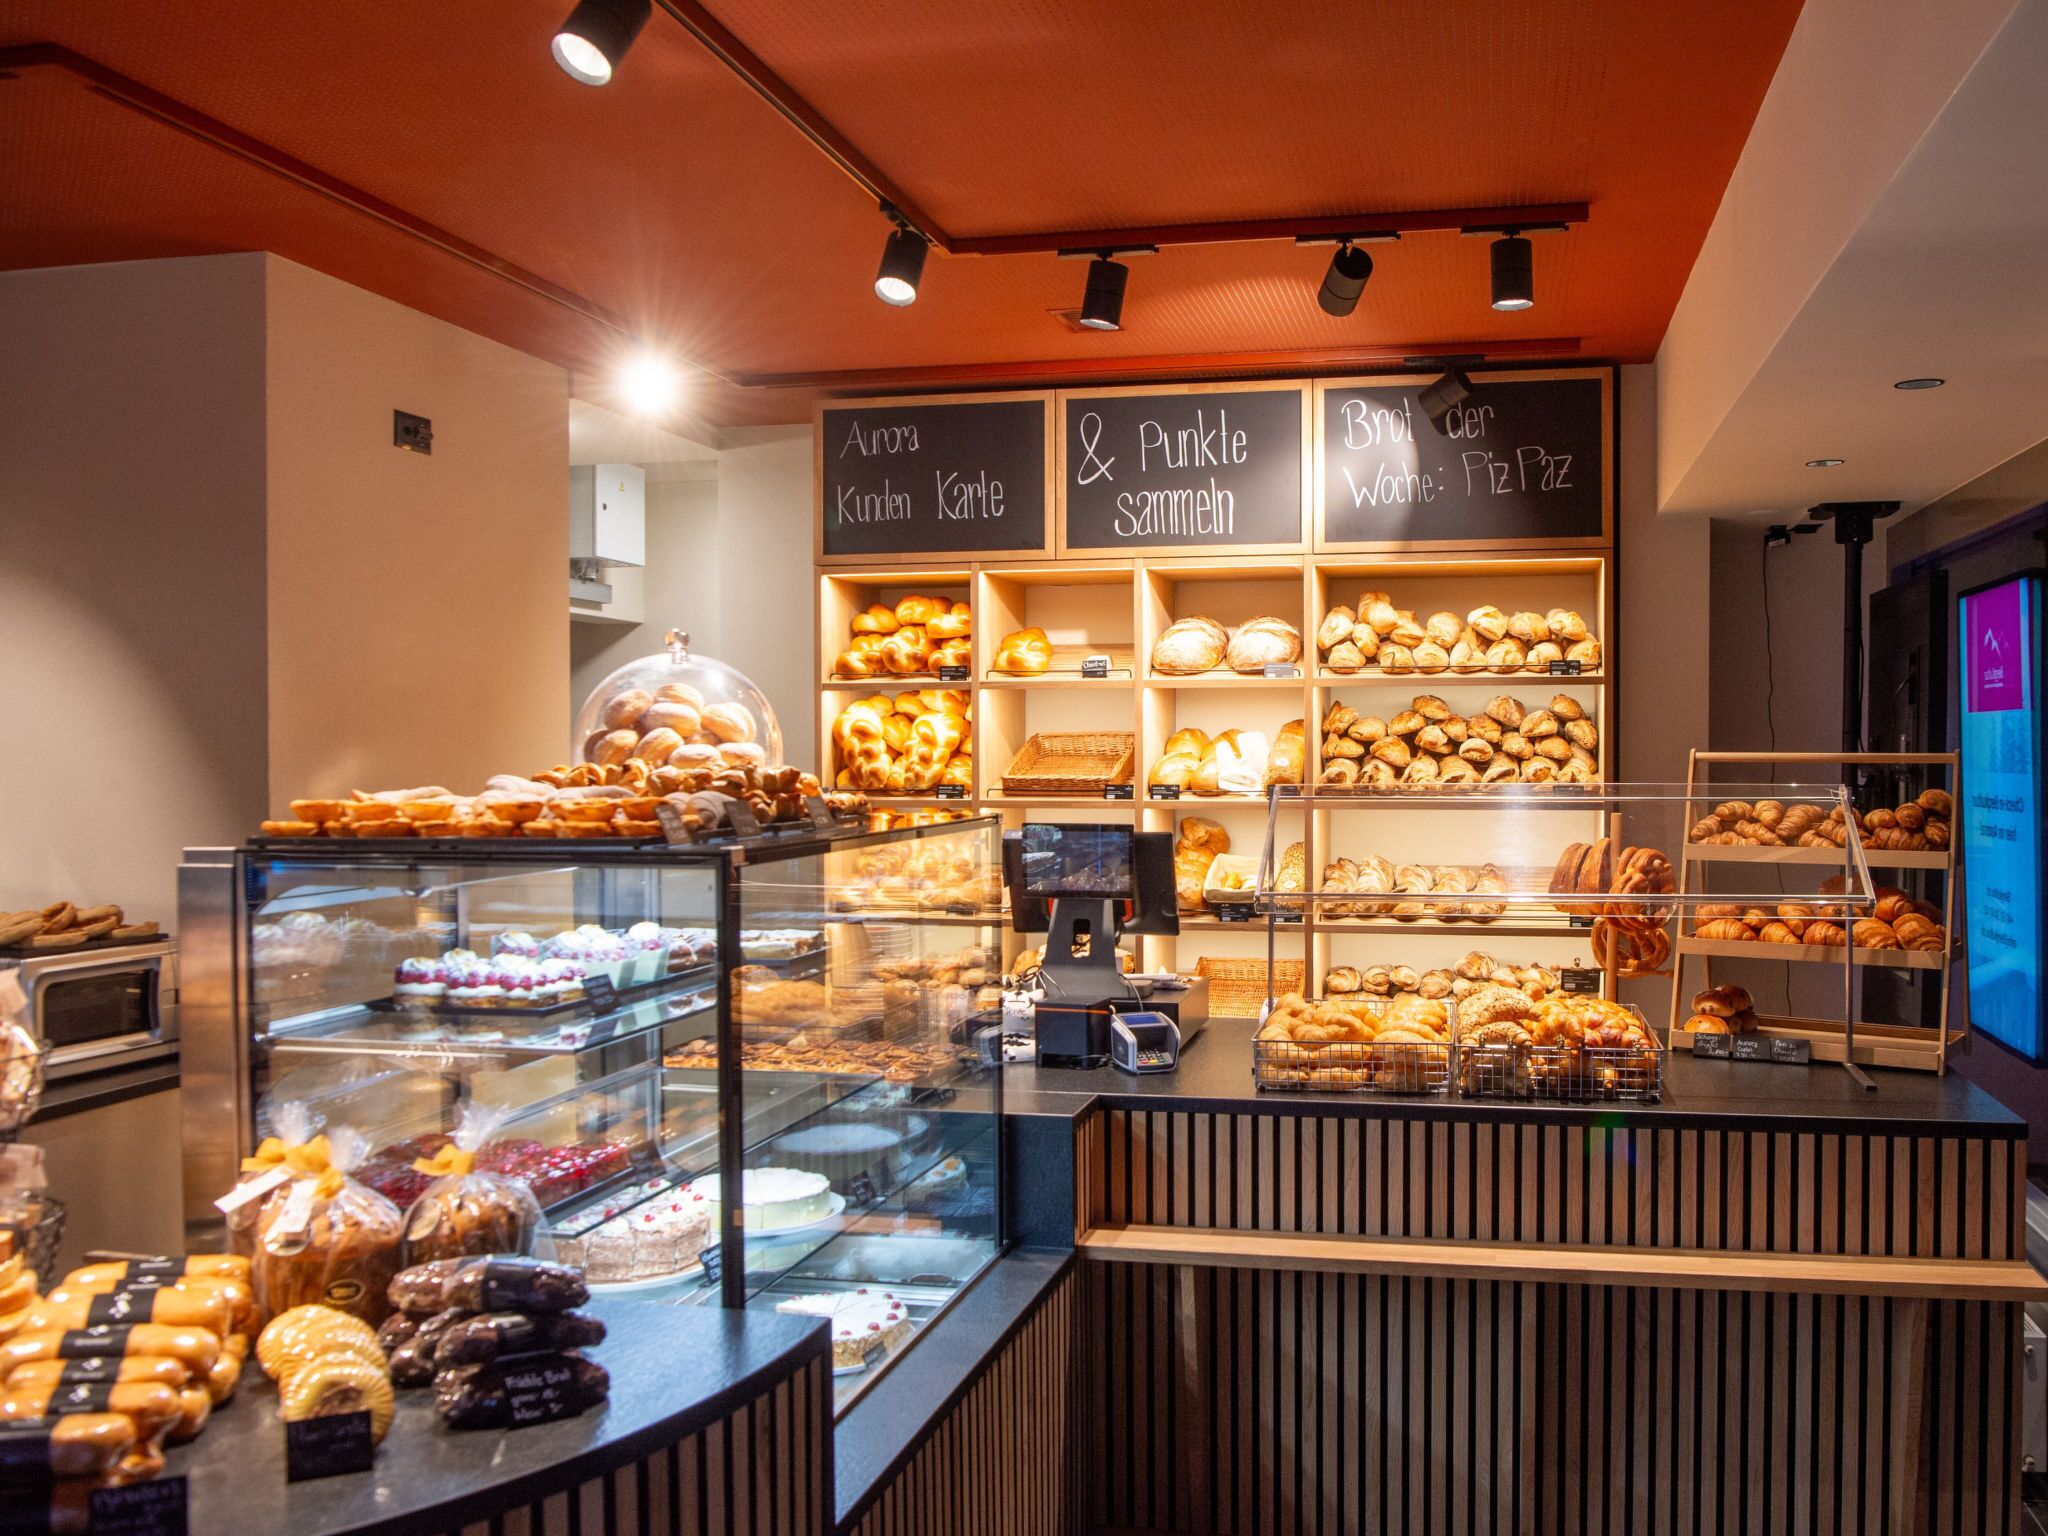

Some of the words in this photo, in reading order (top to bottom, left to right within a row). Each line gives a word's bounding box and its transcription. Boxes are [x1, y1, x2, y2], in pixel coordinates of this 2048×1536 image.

[839, 420, 919, 459] Aurora
[1077, 412, 1115, 485] &
[1139, 409, 1247, 472] Punkte
[1340, 397, 1415, 450] Brot
[1445, 402, 1494, 439] der
[837, 479, 911, 524] Kunden
[936, 470, 1004, 520] Karte
[1114, 477, 1234, 536] sammeln
[1342, 462, 1444, 509] Woche:
